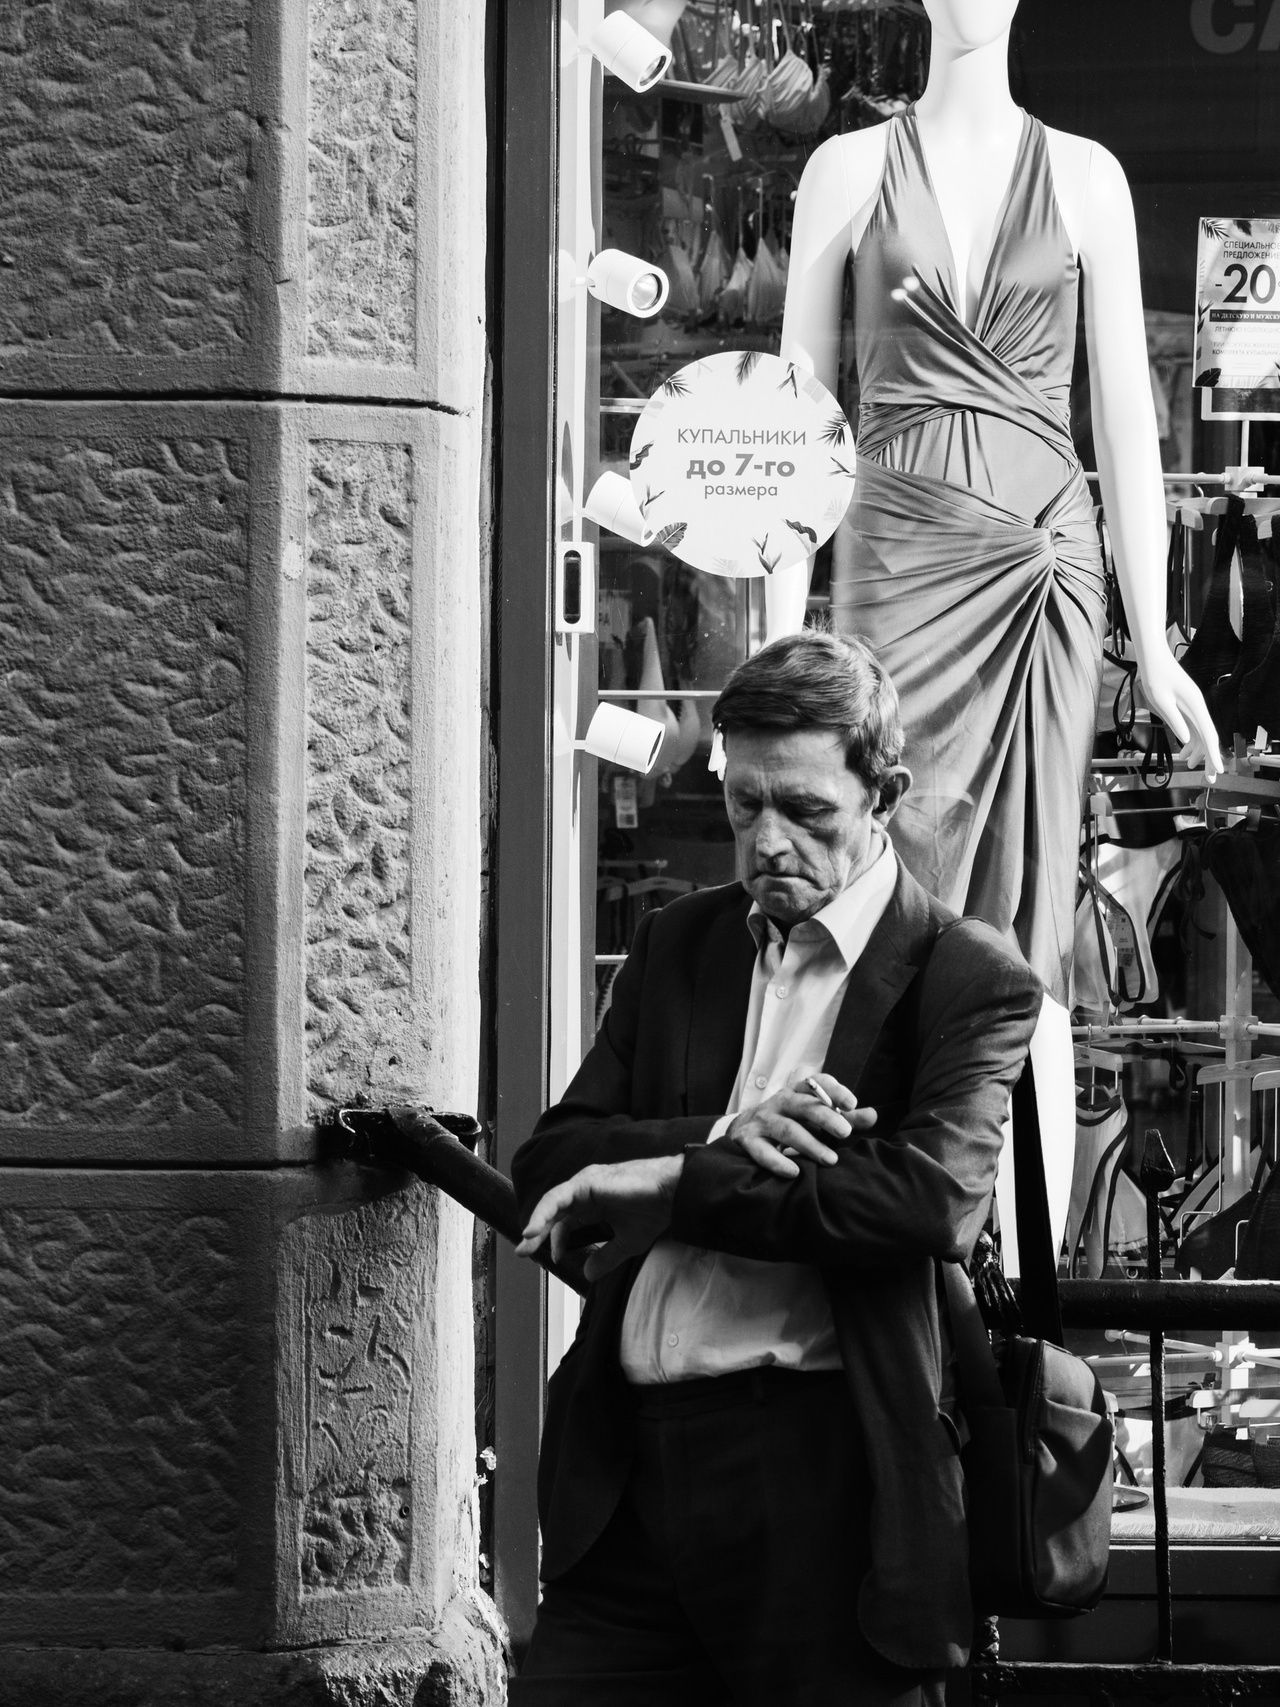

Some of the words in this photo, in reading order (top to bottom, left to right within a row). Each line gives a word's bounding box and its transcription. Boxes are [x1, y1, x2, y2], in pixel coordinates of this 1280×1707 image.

[1223, 240, 1280, 250] СПЕЦИАЛЬНОЕ
[1223, 250, 1280, 260] ПРЕДЛОЖЕНИЕ
[677, 428, 806, 446] КУПАЛЬНИКИ
[686, 459, 726, 480] до
[734, 453, 796, 477] 7-го
[704, 484, 778, 500] размера
